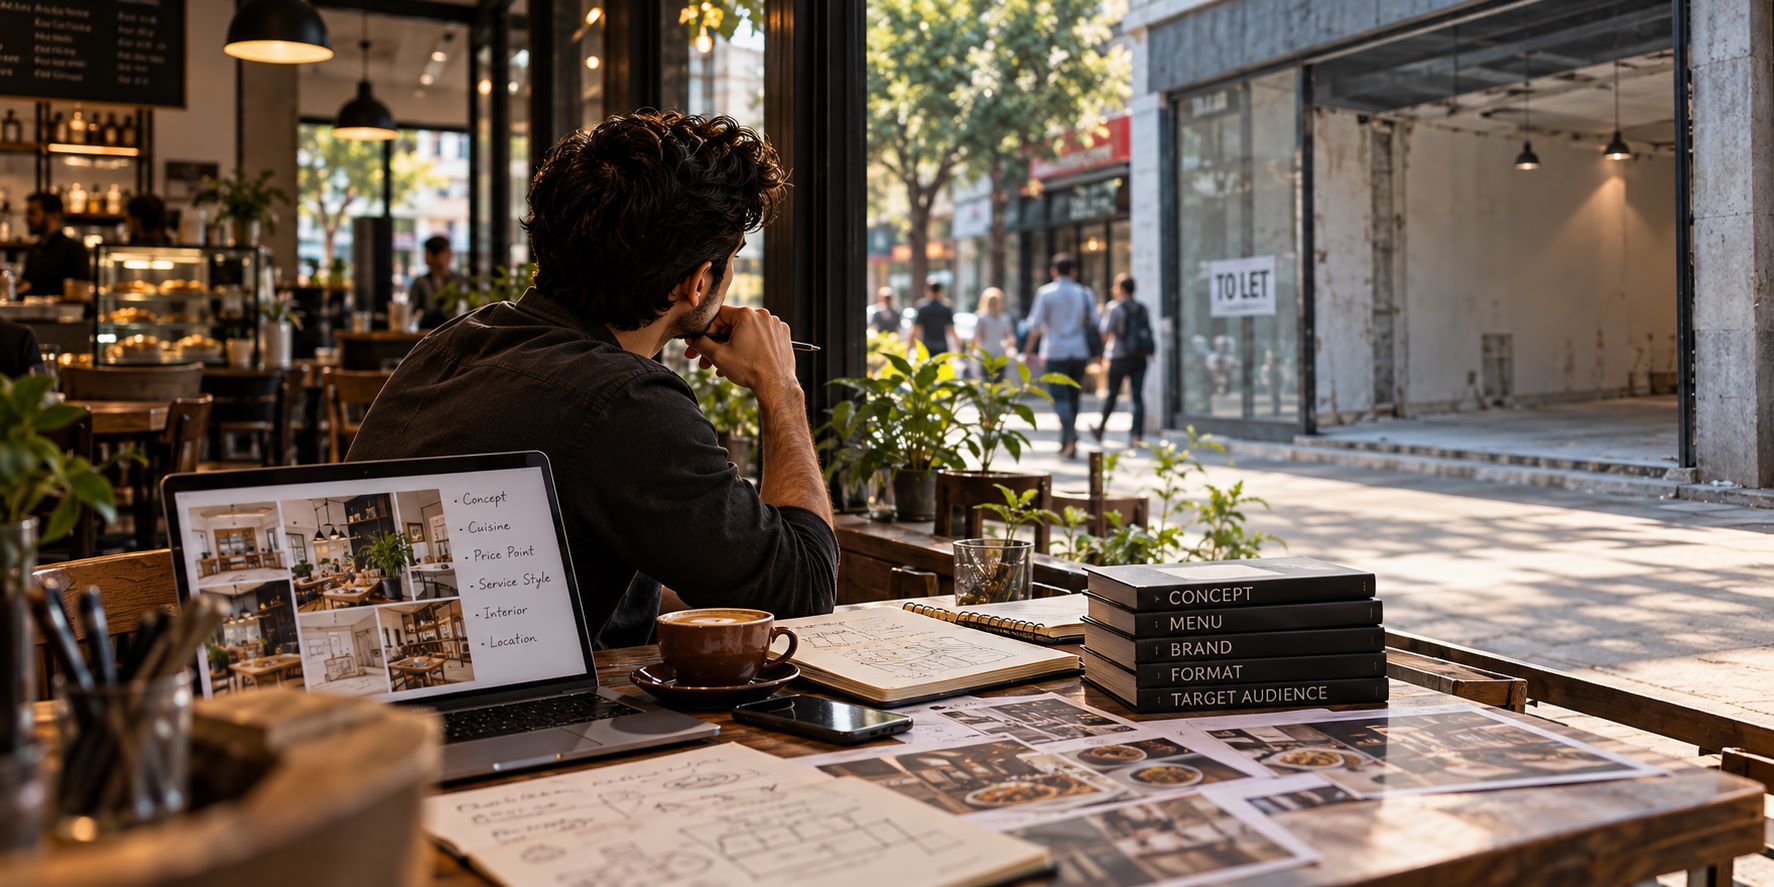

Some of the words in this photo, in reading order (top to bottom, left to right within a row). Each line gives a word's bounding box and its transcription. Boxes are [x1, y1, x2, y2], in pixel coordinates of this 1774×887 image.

[1216, 272, 1236, 301] TO
[1240, 270, 1269, 299] LET
[462, 491, 507, 507] Concept
[468, 521, 511, 534] Cuisine
[474, 549, 502, 562] Price
[507, 545, 535, 559] Point
[479, 577, 518, 590] Service
[523, 571, 551, 589] Style
[1169, 586, 1254, 605] CONCEPT
[483, 606, 528, 619] Interior
[1170, 614, 1223, 632] MENU
[490, 633, 538, 648] Location
[1170, 640, 1233, 657] BRAND
[1171, 665, 1244, 682] FORMAT
[1171, 690, 1237, 707] TARGET
[1241, 686, 1328, 704] AUDIENCE
